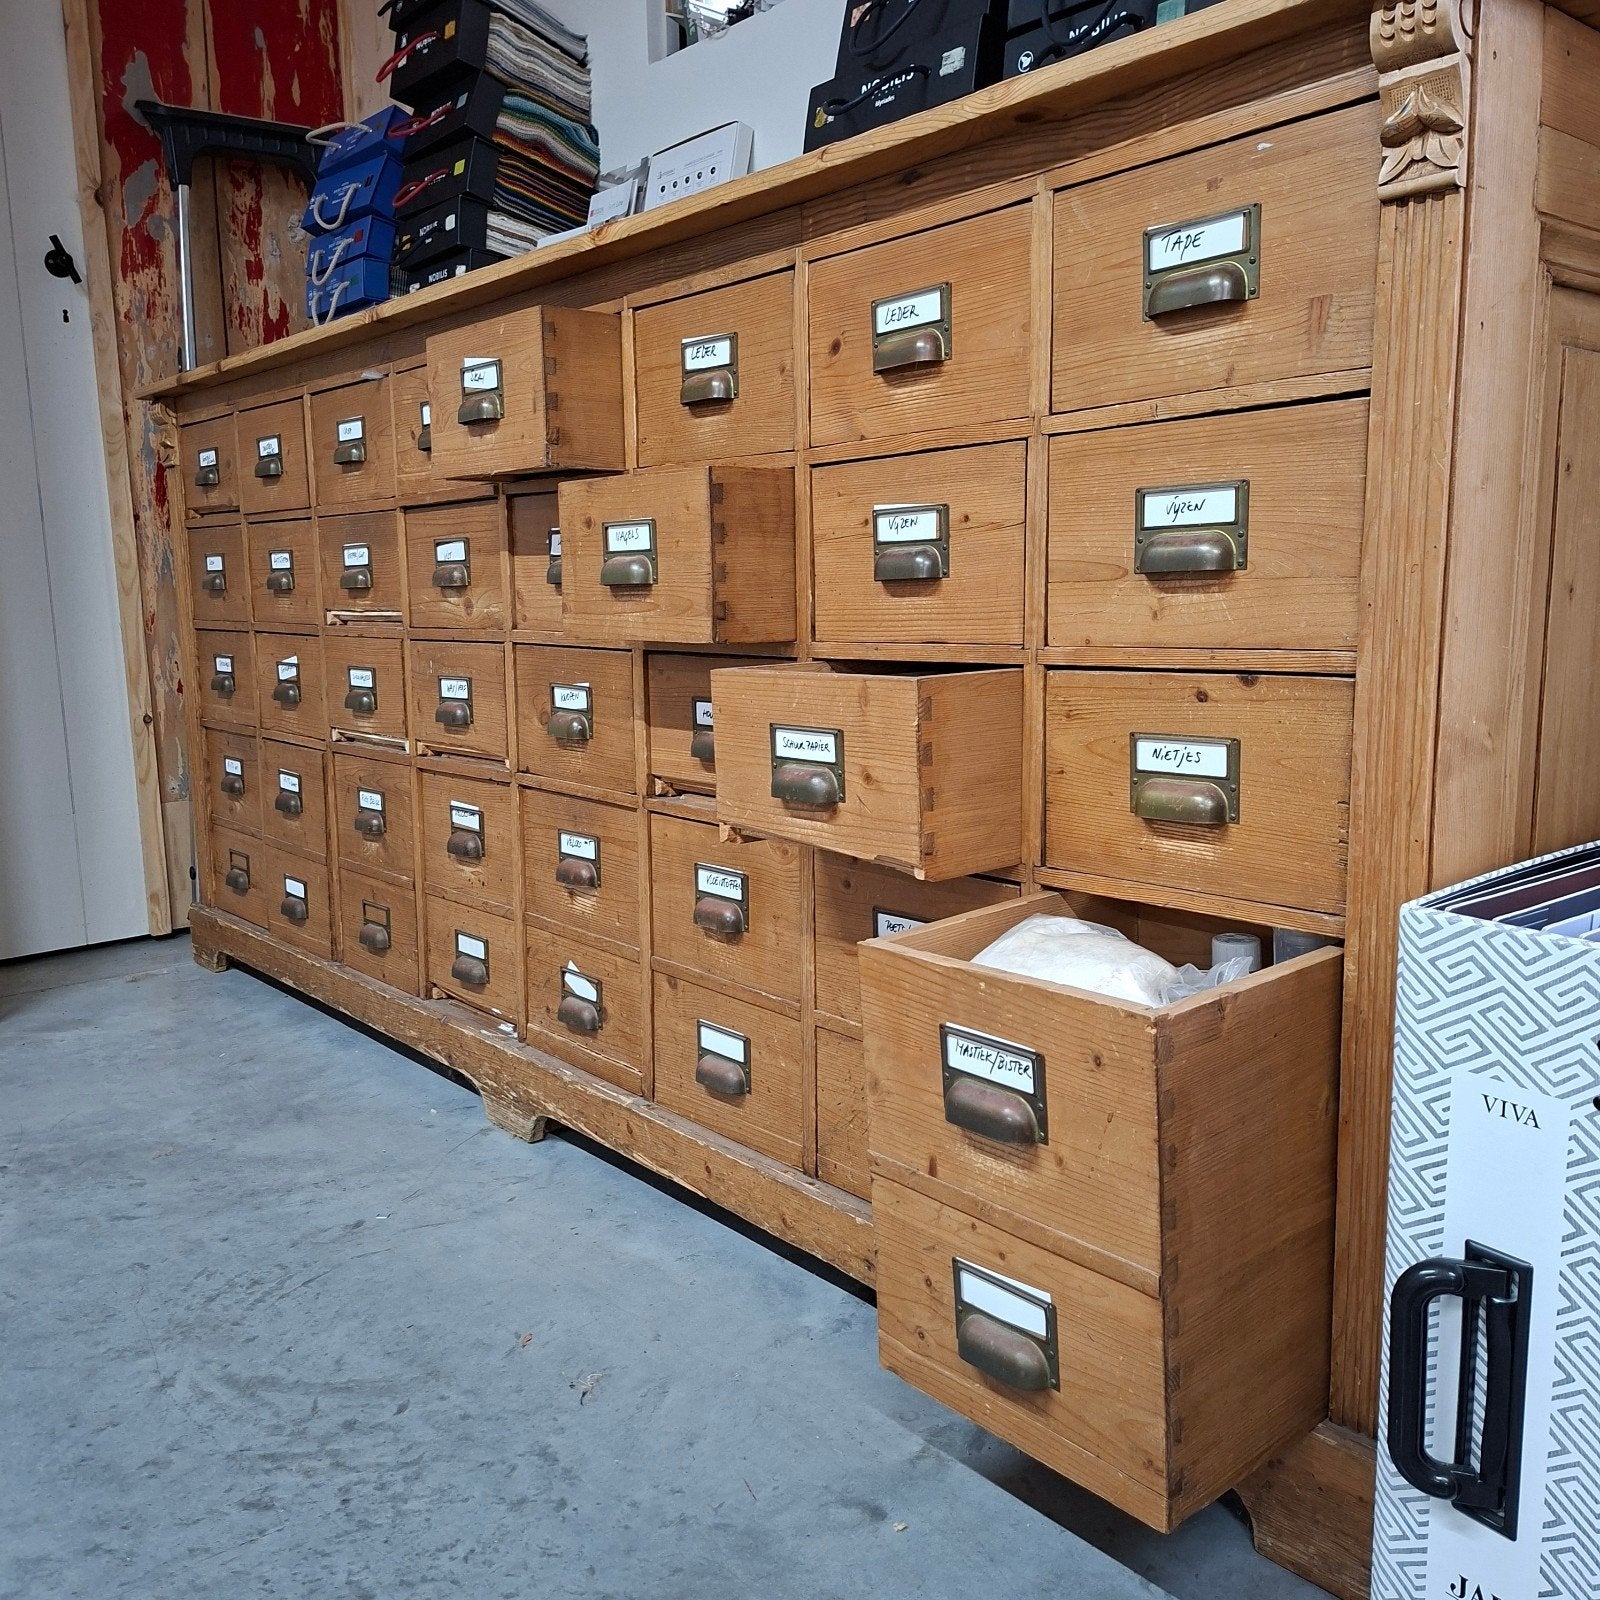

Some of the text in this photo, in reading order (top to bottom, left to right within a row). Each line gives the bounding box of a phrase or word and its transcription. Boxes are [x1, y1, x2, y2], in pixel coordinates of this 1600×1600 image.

[1161, 229, 1205, 260] TAPE
[428, 268, 448, 283] NOBILIS
[884, 304, 919, 325] LEDER
[691, 344, 717, 360] LEDER
[615, 528, 640, 545] NAGELS
[806, 739, 831, 752] PAPIER
[1151, 746, 1202, 768] NIETJES
[1481, 1093, 1541, 1130] VIVA
[1446, 1573, 1502, 1600] JA
